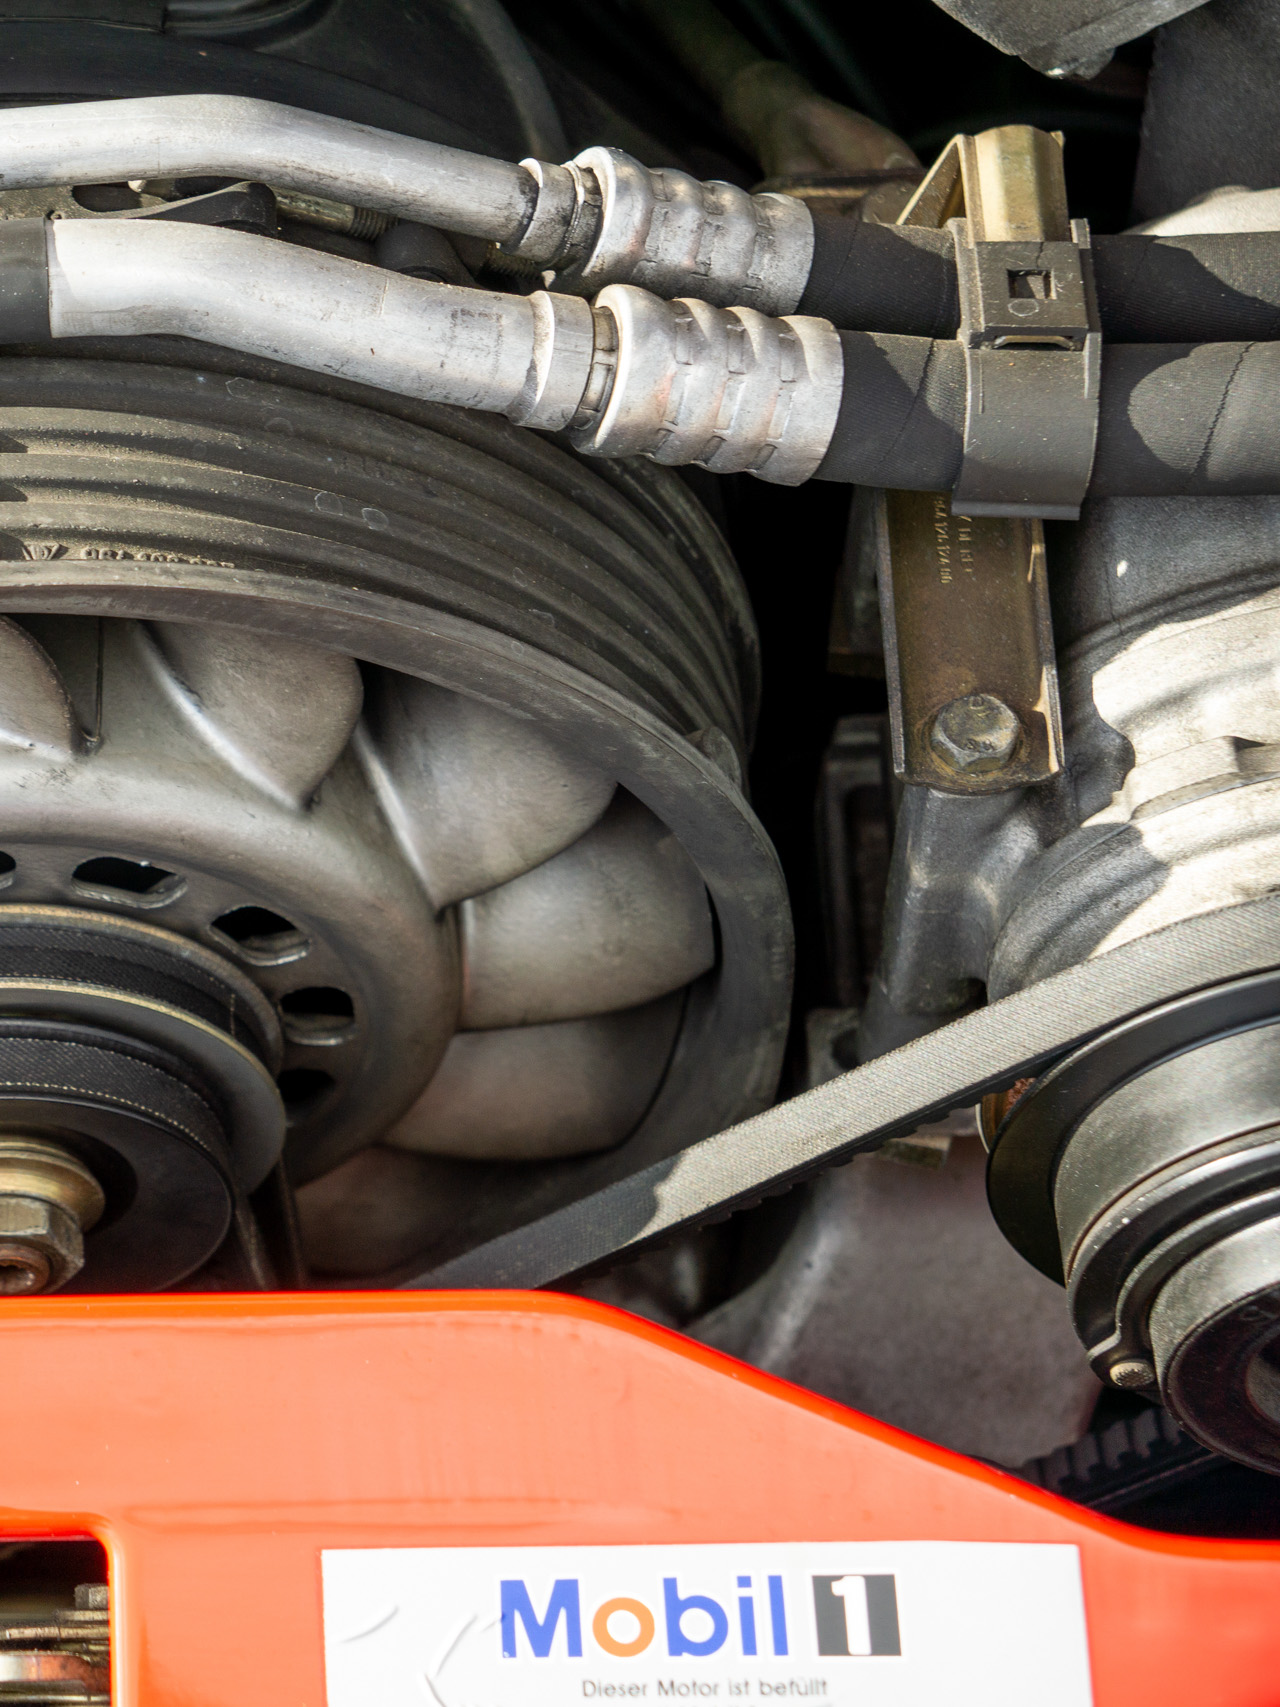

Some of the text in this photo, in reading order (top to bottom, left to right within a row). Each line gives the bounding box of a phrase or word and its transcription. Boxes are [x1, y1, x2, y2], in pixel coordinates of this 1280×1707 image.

[500, 1575, 789, 1658] Mobil
[582, 1677, 827, 1698] Dieser Motor ist befüllt
